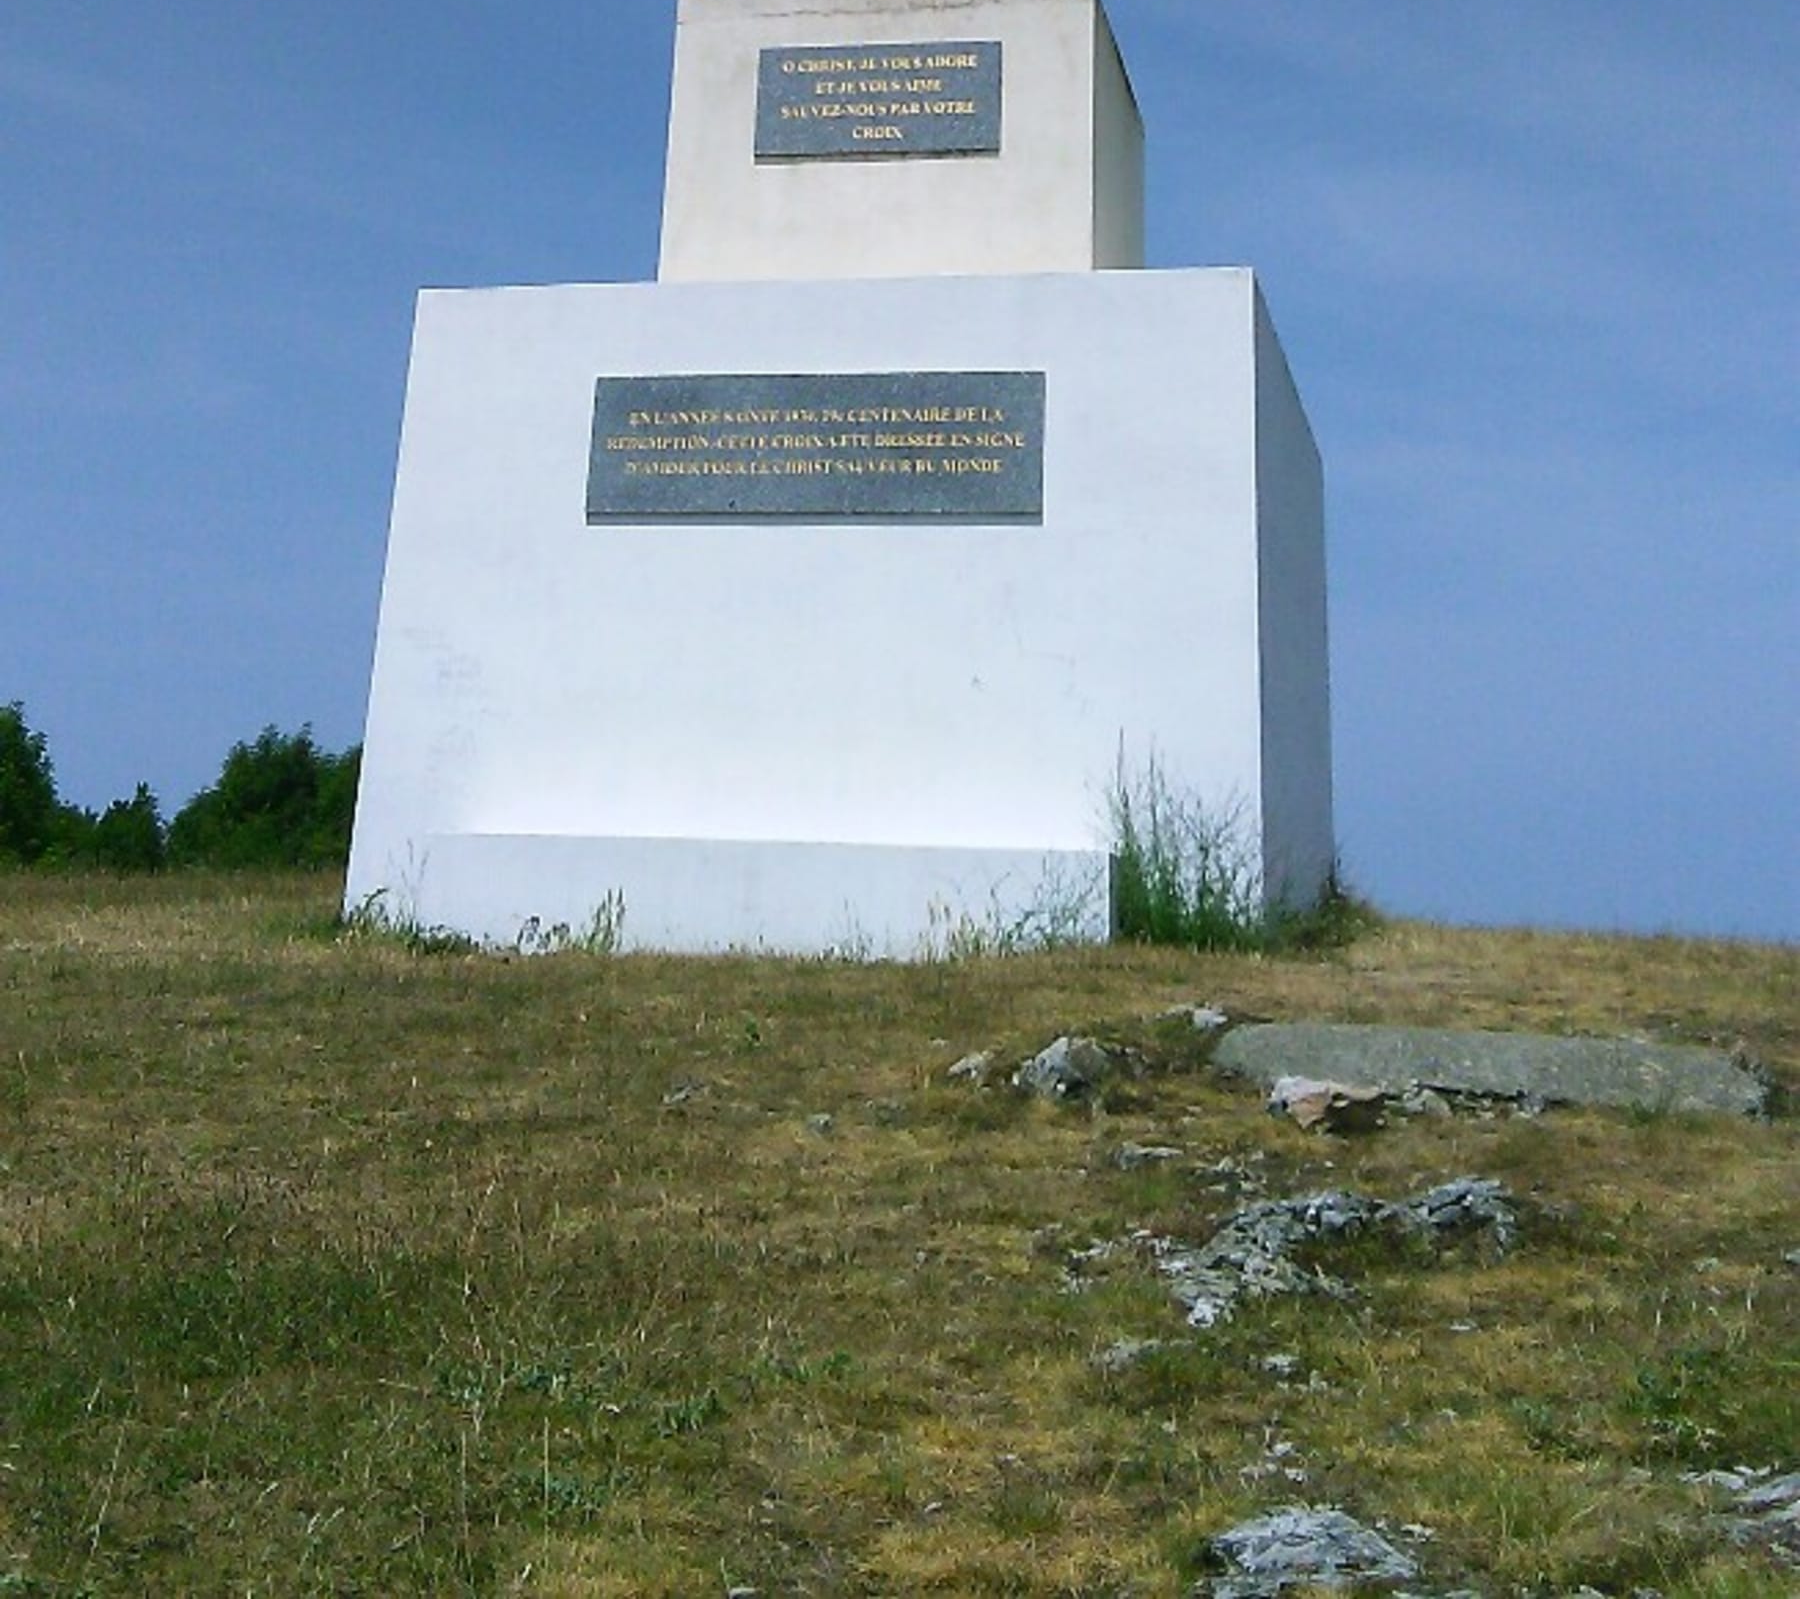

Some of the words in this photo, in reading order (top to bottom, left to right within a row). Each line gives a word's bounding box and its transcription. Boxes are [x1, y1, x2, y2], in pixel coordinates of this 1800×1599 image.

[783, 60, 796, 74] O
[860, 58, 877, 71] JE
[880, 56, 923, 70] VOUS
[925, 54, 978, 69] ADORE
[815, 81, 834, 95] ET
[836, 81, 856, 94] JE
[859, 80, 901, 93] VOUS
[903, 79, 942, 92] AIME
[890, 103, 921, 115] PAR
[923, 101, 976, 115] VOTRE
[852, 125, 904, 139] CROIX
[847, 406, 949, 423] CENTENAIRE
[953, 406, 977, 422] DE
[980, 406, 1005, 423] LA
[771, 434, 824, 449] CROIX
[950, 432, 972, 447] EN
[975, 432, 1025, 447] SIGNE
[750, 461, 771, 475] LE
[772, 459, 833, 475] CHRIST
[834, 458, 912, 474] SAUVEUR
[914, 458, 935, 473] DU
[941, 458, 1003, 474] MONDE
